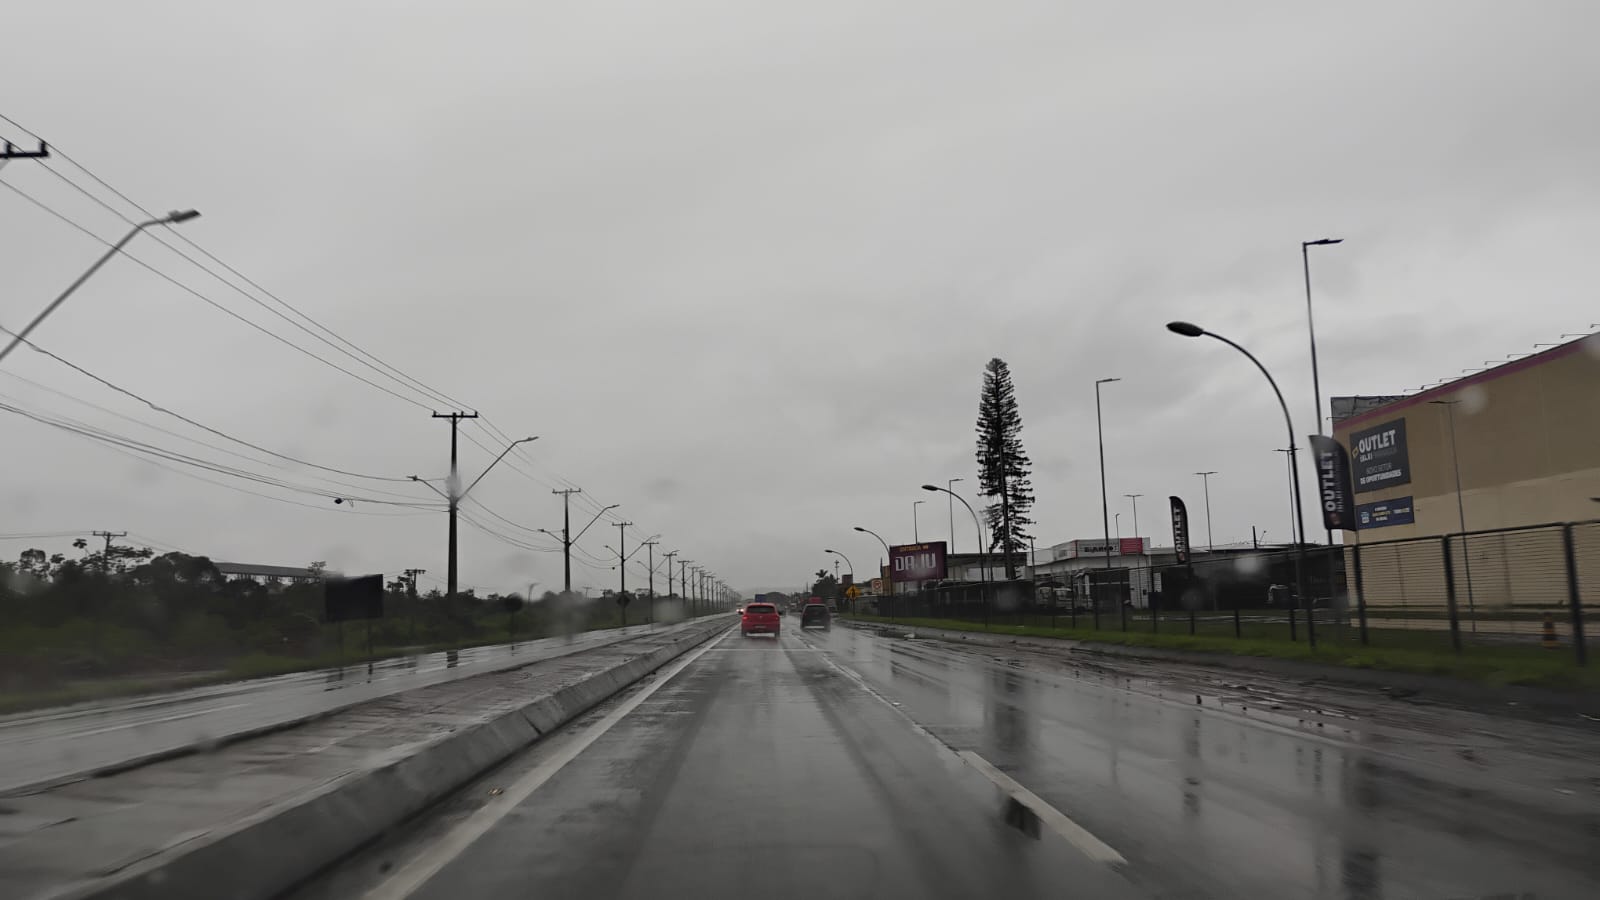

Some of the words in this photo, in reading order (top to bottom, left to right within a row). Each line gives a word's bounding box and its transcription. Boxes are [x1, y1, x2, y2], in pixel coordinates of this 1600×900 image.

[1359, 429, 1396, 453] OUTLET
[1320, 451, 1337, 512] OUTLET
[1173, 507, 1181, 552] OUTLET
